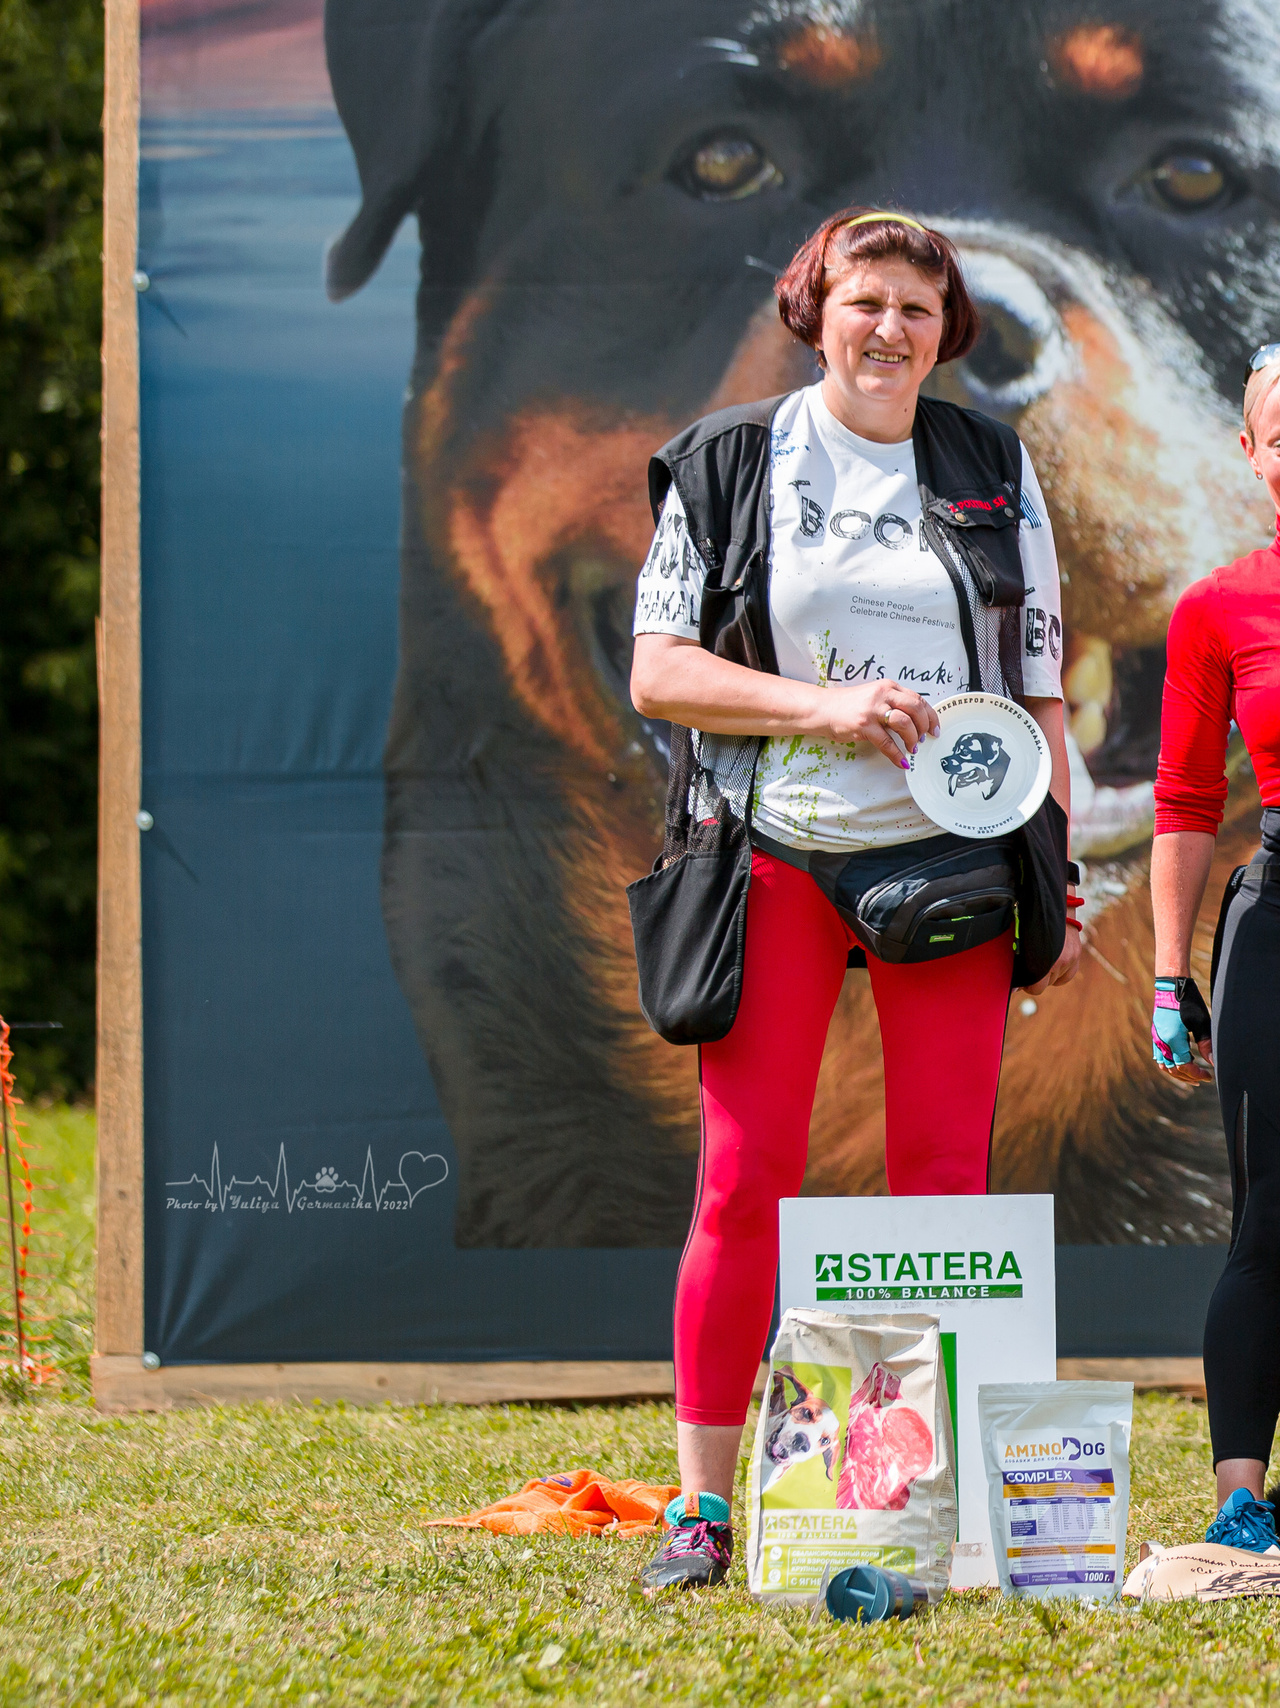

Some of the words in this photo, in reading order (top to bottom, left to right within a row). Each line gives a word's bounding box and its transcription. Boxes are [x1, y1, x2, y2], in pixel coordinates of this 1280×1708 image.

[851, 595, 884, 607] Chinese
[886, 600, 914, 612] People
[850, 605, 888, 618] Celebrate
[889, 611, 920, 624] Chinese
[922, 616, 956, 630] Festivals
[937, 697, 985, 714] ТВЕЙЛЕРОВ
[848, 1251, 1023, 1282] STATERA
[846, 1288, 891, 1301] 100%
[902, 1285, 990, 1300] BALANCE
[1006, 1470, 1072, 1483] COMPLEX
[779, 1515, 857, 1530] STATERA
[799, 1577, 821, 1586] ЯГНЕ
[1084, 1572, 1104, 1582] 1000
